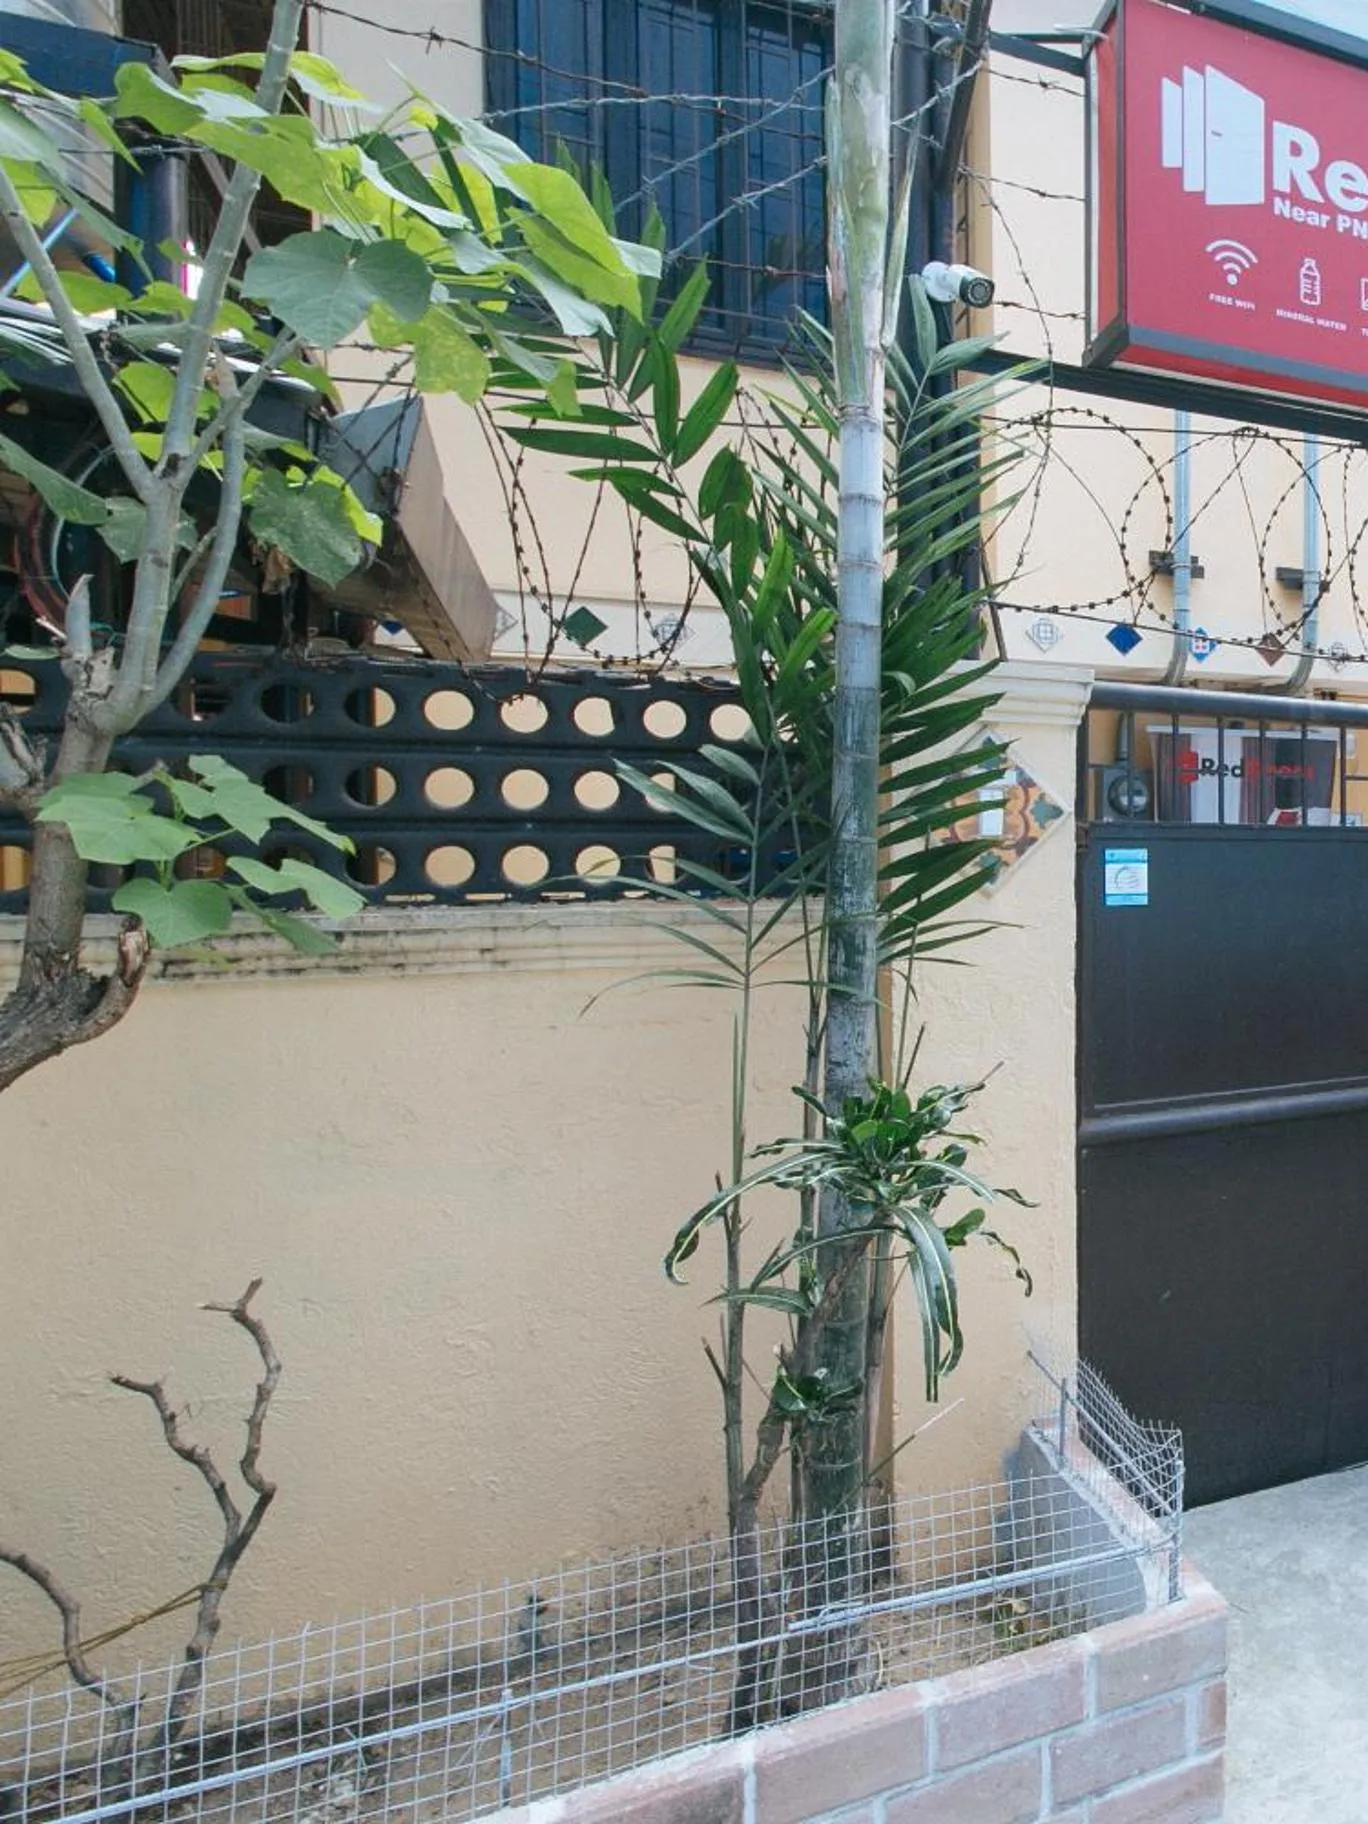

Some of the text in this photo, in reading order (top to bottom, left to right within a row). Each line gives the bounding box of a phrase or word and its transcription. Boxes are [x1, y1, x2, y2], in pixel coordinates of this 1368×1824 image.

[1273, 197, 1330, 228] Near
[1209, 292, 1233, 305] FREE
[1276, 308, 1347, 331] MINERAL WATER
